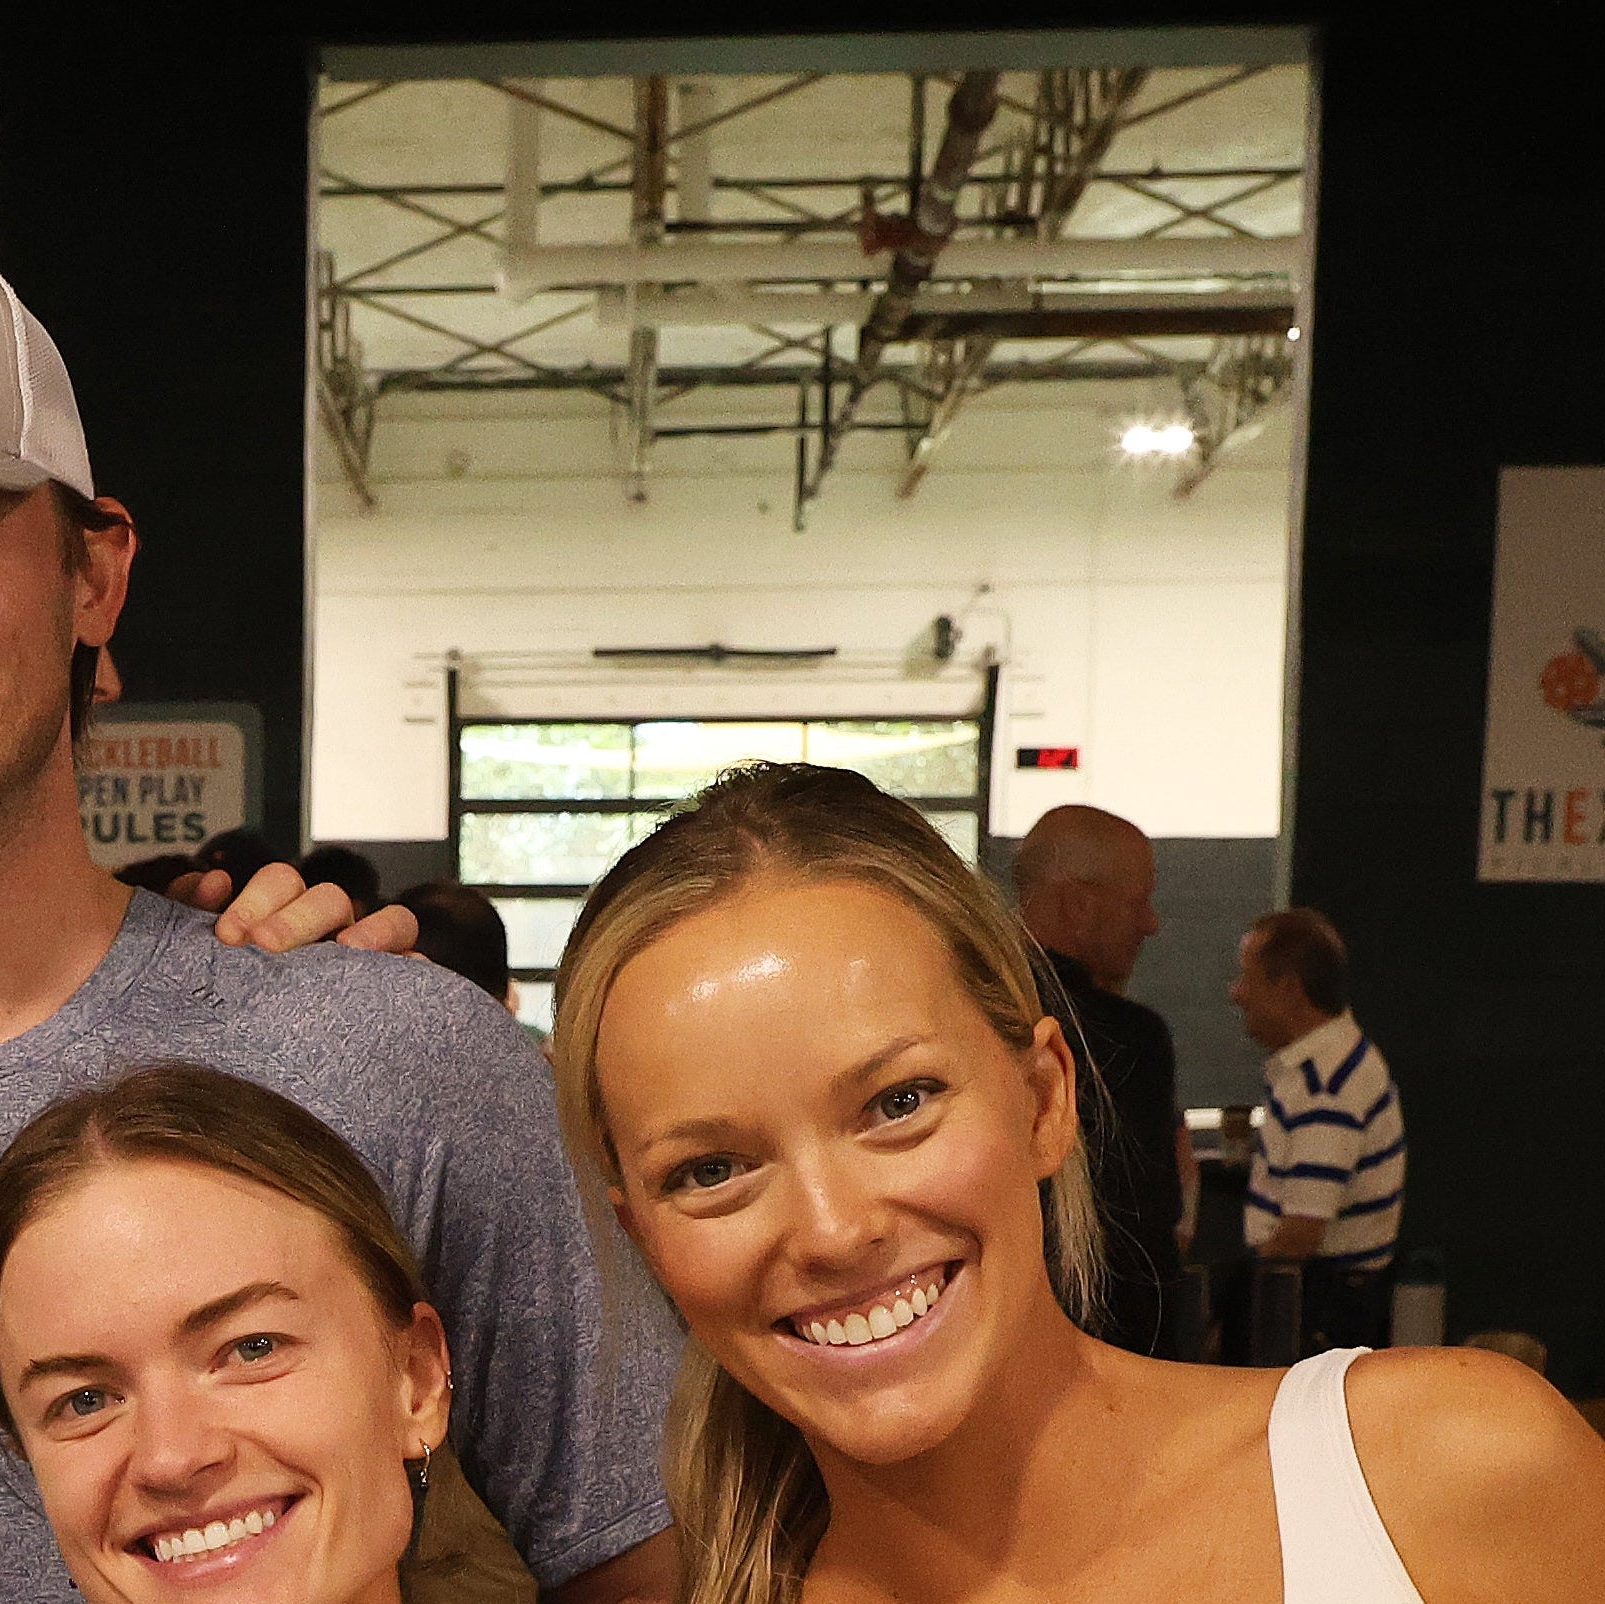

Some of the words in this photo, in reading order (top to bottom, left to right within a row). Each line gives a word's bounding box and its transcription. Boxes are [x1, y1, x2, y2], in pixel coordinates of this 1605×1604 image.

[88, 736, 222, 771] CKLEBALL
[80, 773, 130, 806] PEN
[138, 773, 206, 805] PLAY
[81, 811, 207, 844] ULES
